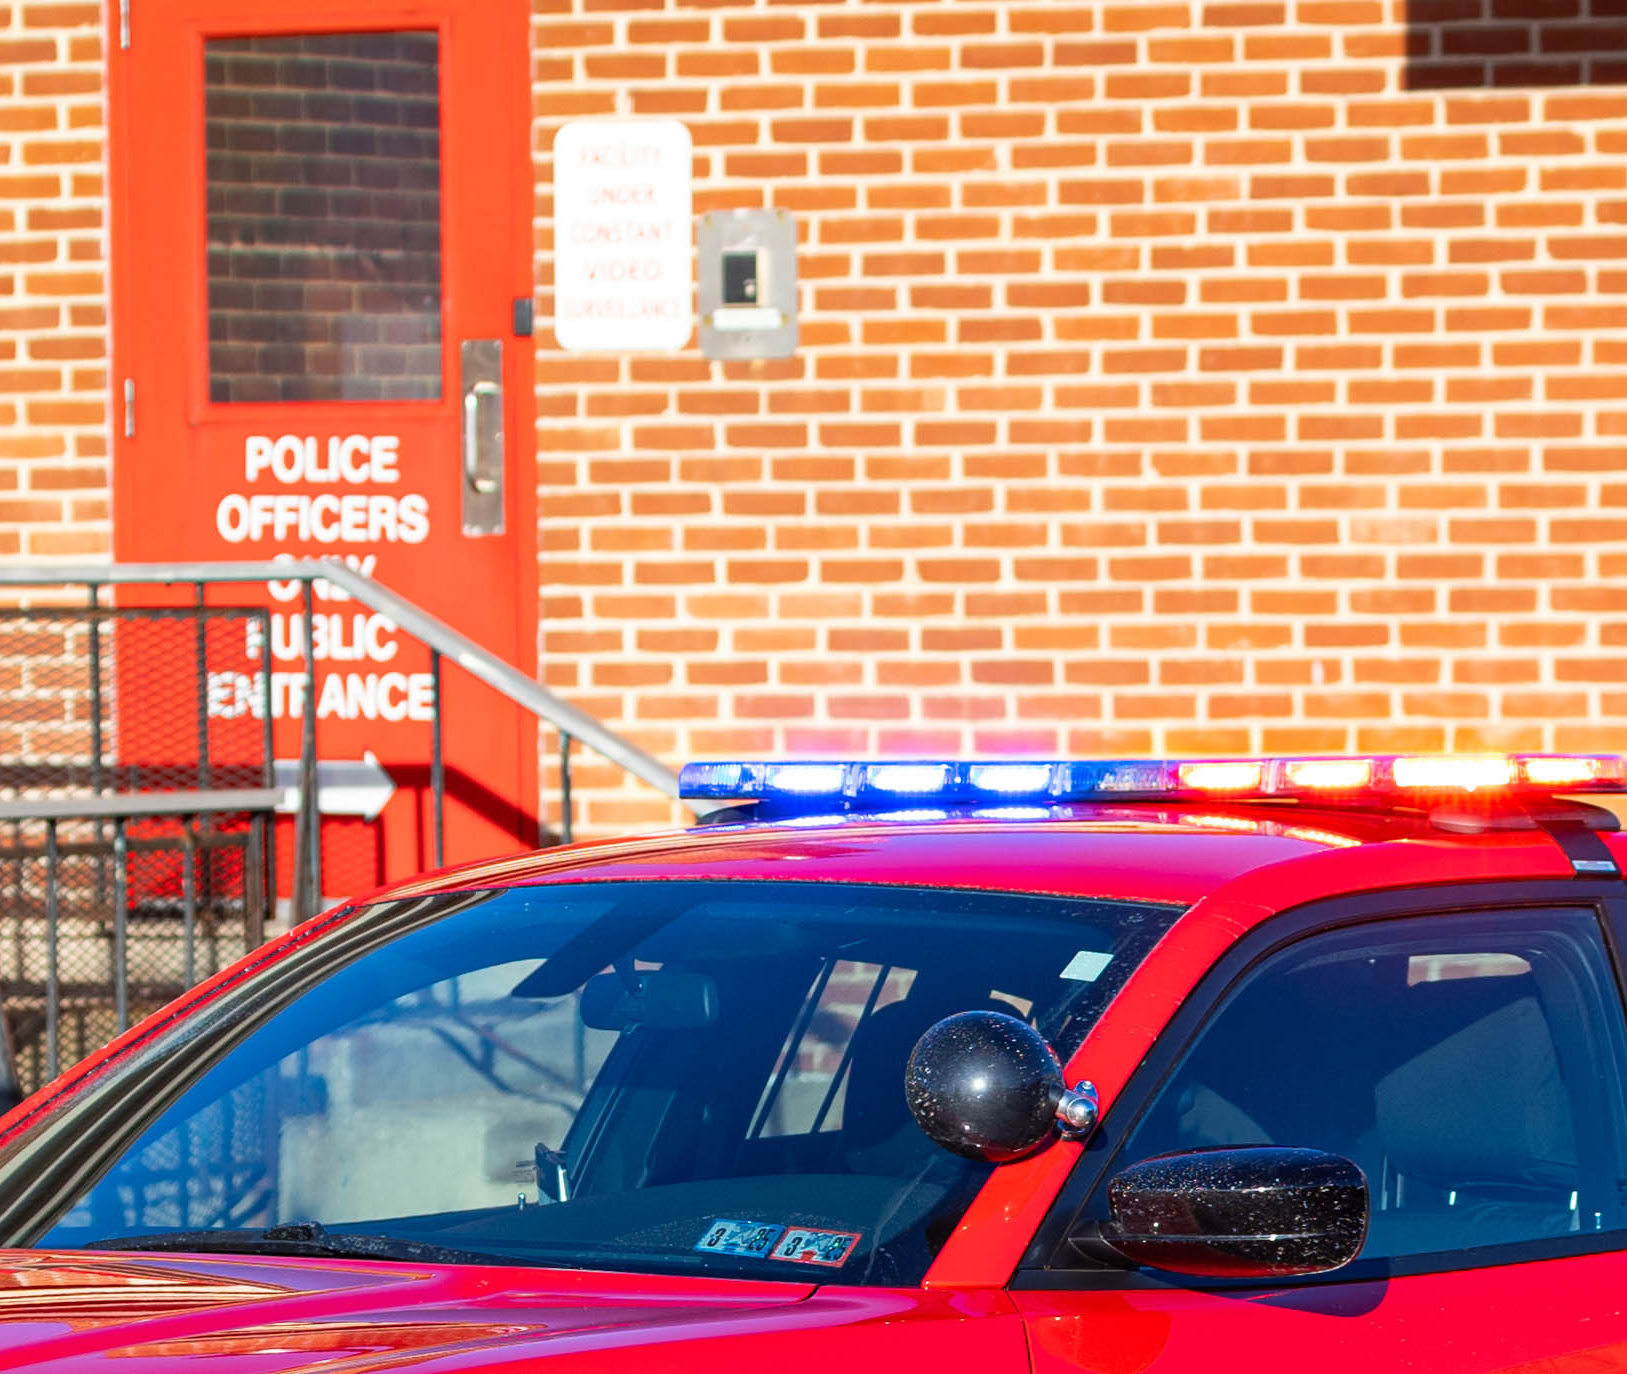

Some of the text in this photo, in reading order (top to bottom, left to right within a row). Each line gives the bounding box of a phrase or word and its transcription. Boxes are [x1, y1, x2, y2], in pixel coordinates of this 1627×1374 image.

[587, 184, 655, 205] UNDER
[584, 259, 661, 281] VIDEO
[245, 435, 400, 484] POLICE
[216, 493, 430, 543] OFFICERS
[707, 1227, 726, 1248] 3
[783, 1236, 804, 1257] 3
